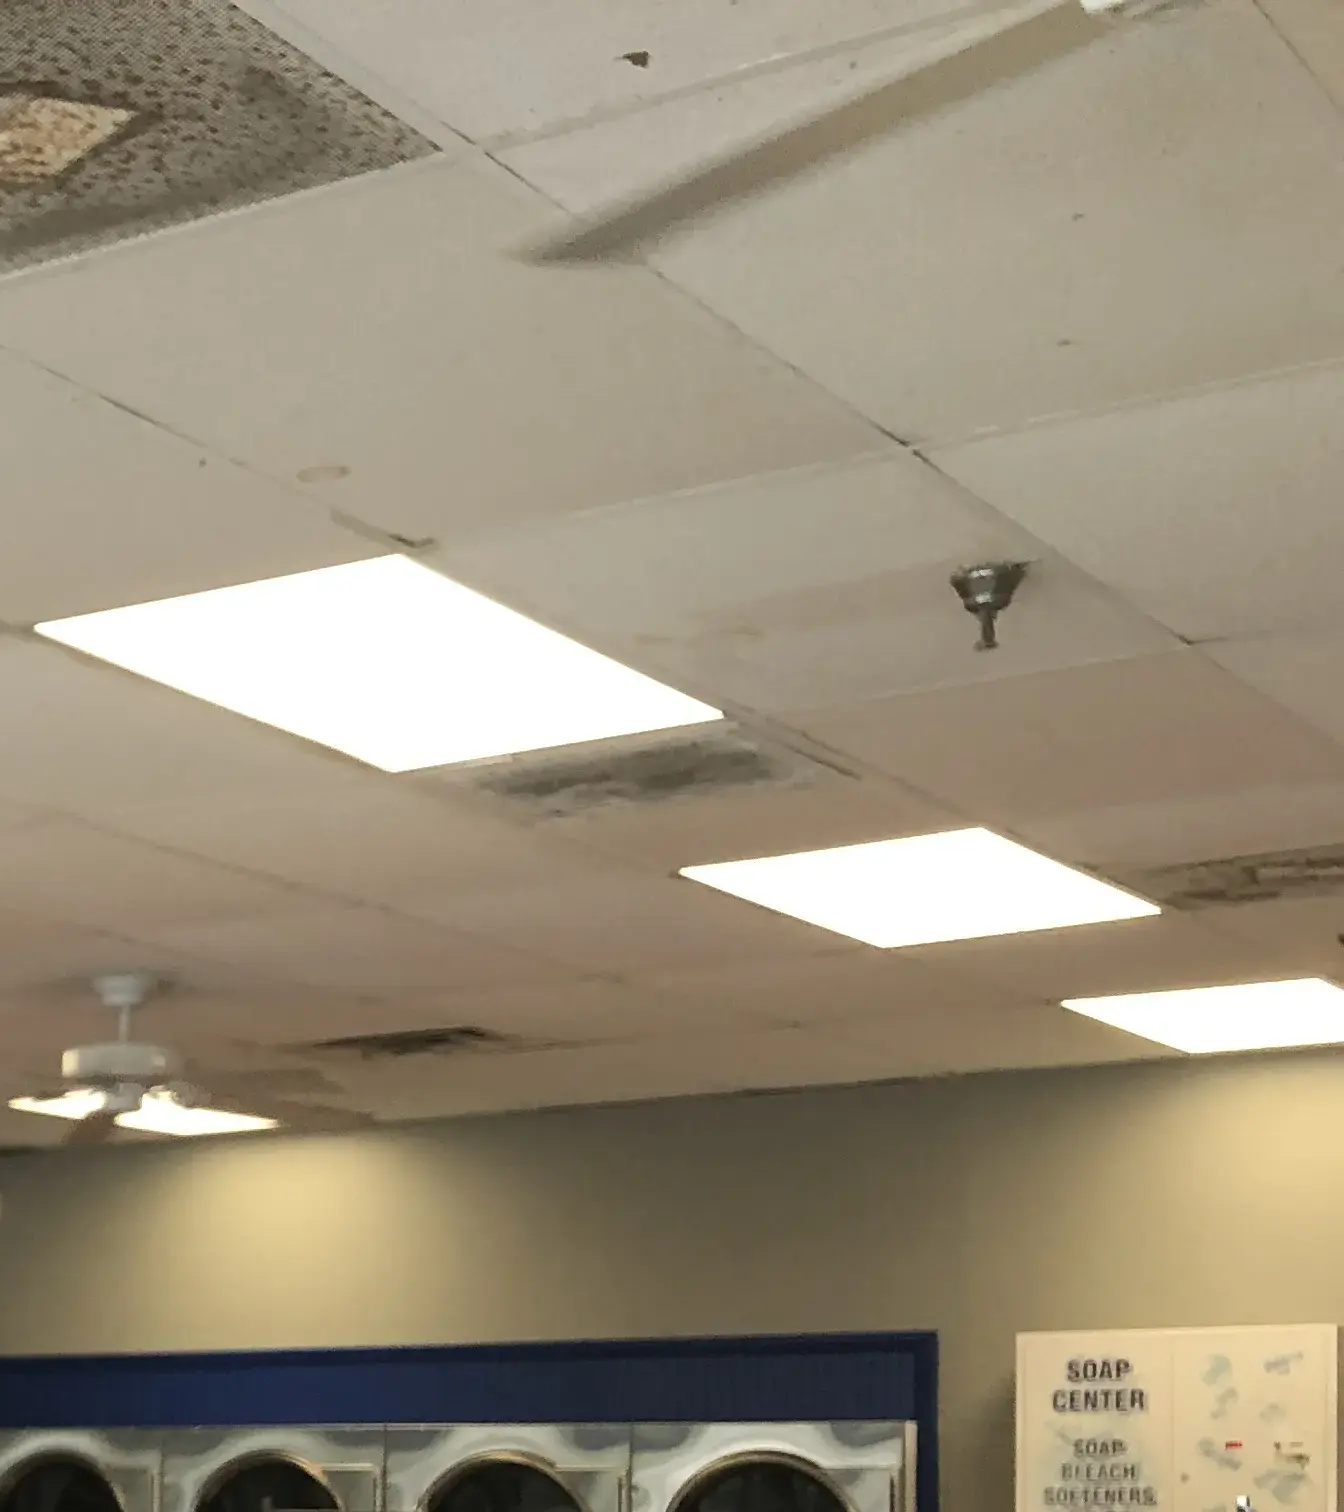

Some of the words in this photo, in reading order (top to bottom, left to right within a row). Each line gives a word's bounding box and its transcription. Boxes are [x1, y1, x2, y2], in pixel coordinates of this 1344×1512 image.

[1067, 1359, 1130, 1382] SOAP
[1052, 1389, 1145, 1412] CENTER
[1073, 1439, 1124, 1458] SOAP
[1061, 1462, 1135, 1482] BLEACH
